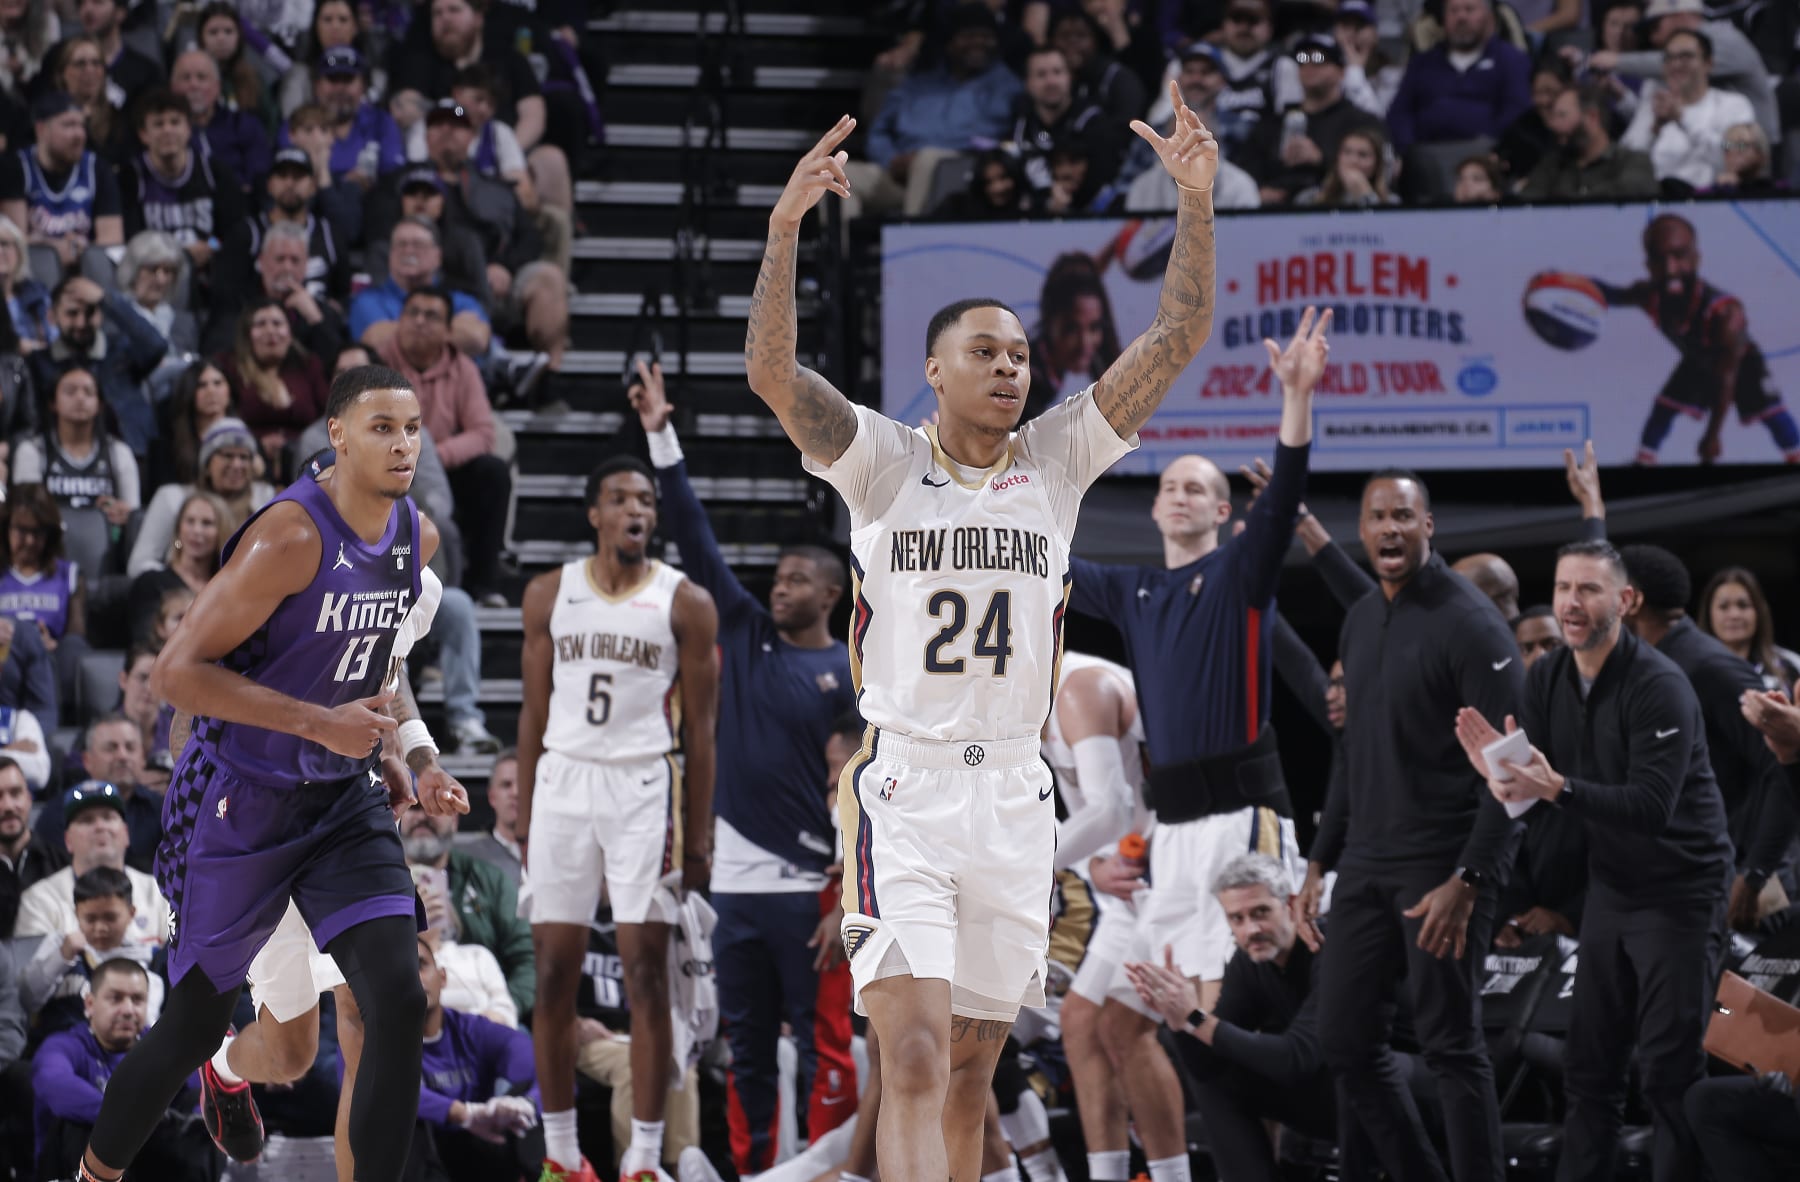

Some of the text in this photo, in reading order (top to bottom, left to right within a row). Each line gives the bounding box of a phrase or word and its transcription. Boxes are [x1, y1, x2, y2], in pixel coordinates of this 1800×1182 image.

[1257, 252, 1429, 305] HARLEM
[1223, 303, 1465, 348] GLOBROTTERS
[1201, 363, 1272, 397] 2024
[1373, 360, 1446, 395] TOUR
[991, 474, 1031, 490] botta
[890, 527, 1048, 579] NEW ORLEANS
[315, 588, 411, 633] KINGS
[352, 591, 398, 601] SACRAMENTO
[590, 633, 662, 671] ORLEANS
[924, 588, 1014, 678] 24
[333, 634, 380, 682] 13
[586, 673, 613, 726] 5
